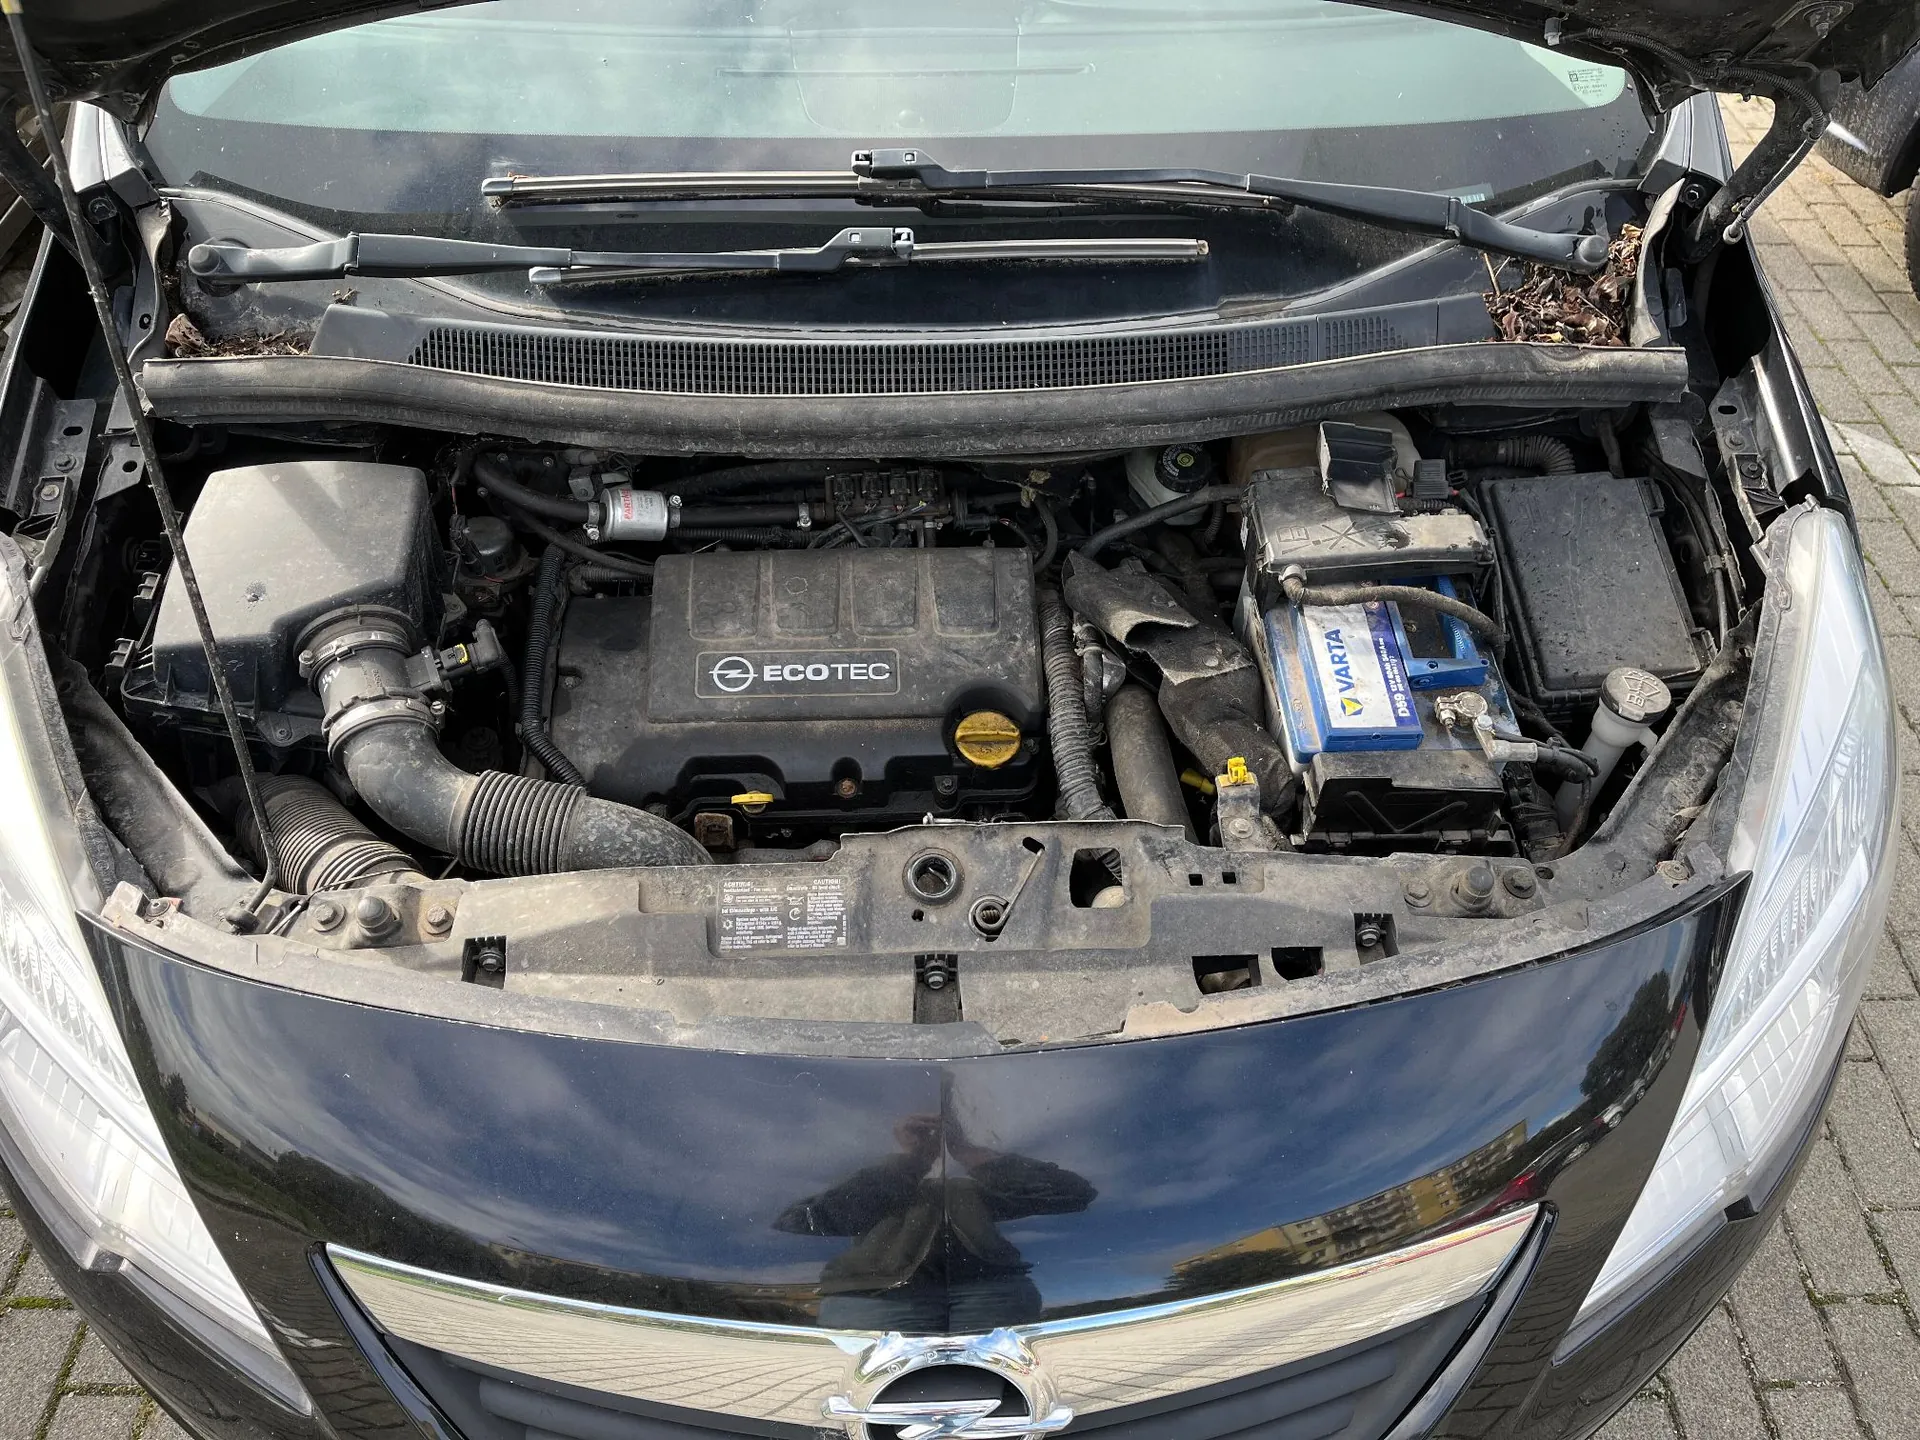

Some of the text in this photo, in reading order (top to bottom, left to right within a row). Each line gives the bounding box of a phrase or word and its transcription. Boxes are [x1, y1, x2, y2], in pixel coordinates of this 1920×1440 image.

[763, 663, 891, 682] ECOTEC
[1324, 629, 1354, 693] VARTA
[1394, 693, 1411, 717] D59
